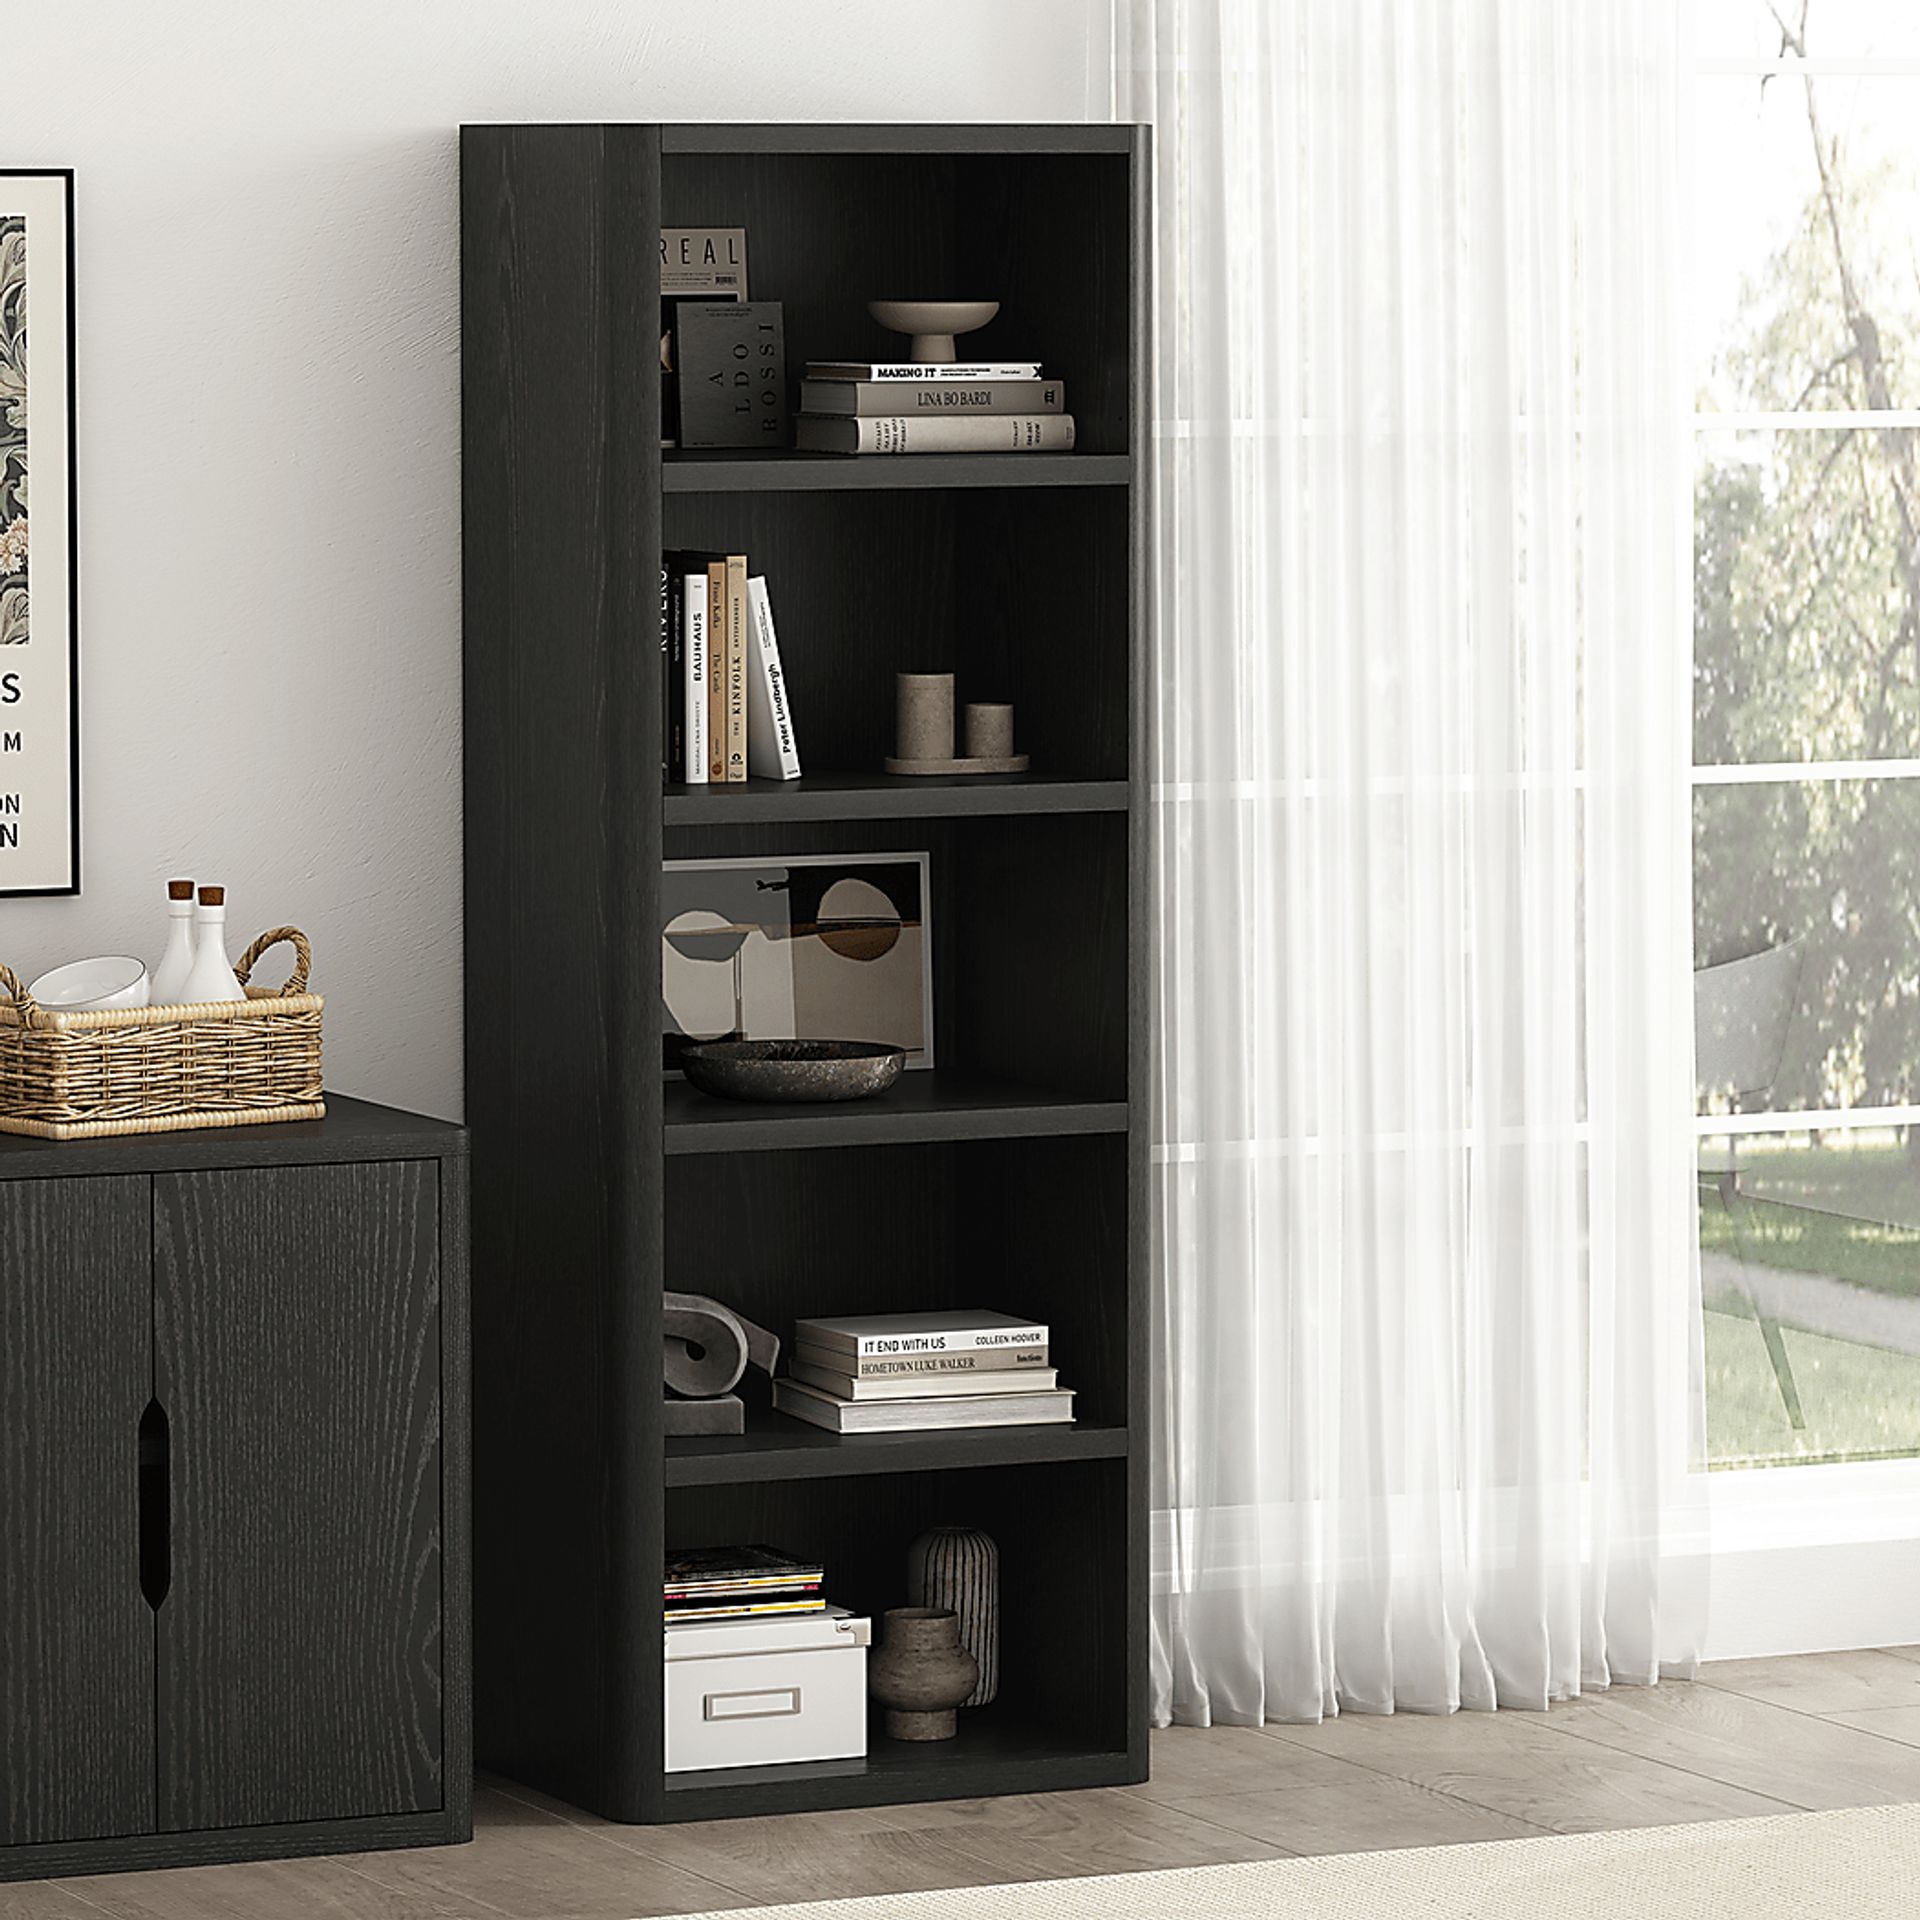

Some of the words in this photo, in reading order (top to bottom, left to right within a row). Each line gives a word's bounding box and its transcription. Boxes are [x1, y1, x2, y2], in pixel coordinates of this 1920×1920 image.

[758, 323, 777, 432] ROSSI
[877, 367, 923, 378] MAKING
[924, 367, 937, 378] IT
[917, 391, 942, 407] LINA
[943, 391, 960, 406] BO
[960, 390, 992, 406] BARDI
[693, 612, 702, 682] BAUHAUS
[732, 656, 741, 715] KINFOLK
[767, 663, 786, 722] Lindbergh
[779, 723, 792, 754] Peter
[864, 1341, 874, 1353] IT
[877, 1340, 899, 1353] END
[901, 1338, 929, 1351] WITH
[930, 1336, 946, 1349] US
[975, 1334, 1009, 1345] COLLEEN
[1011, 1333, 1041, 1343] HOOVER
[861, 1361, 914, 1375] HOMETOWN
[939, 1356, 976, 1370] WALKER
